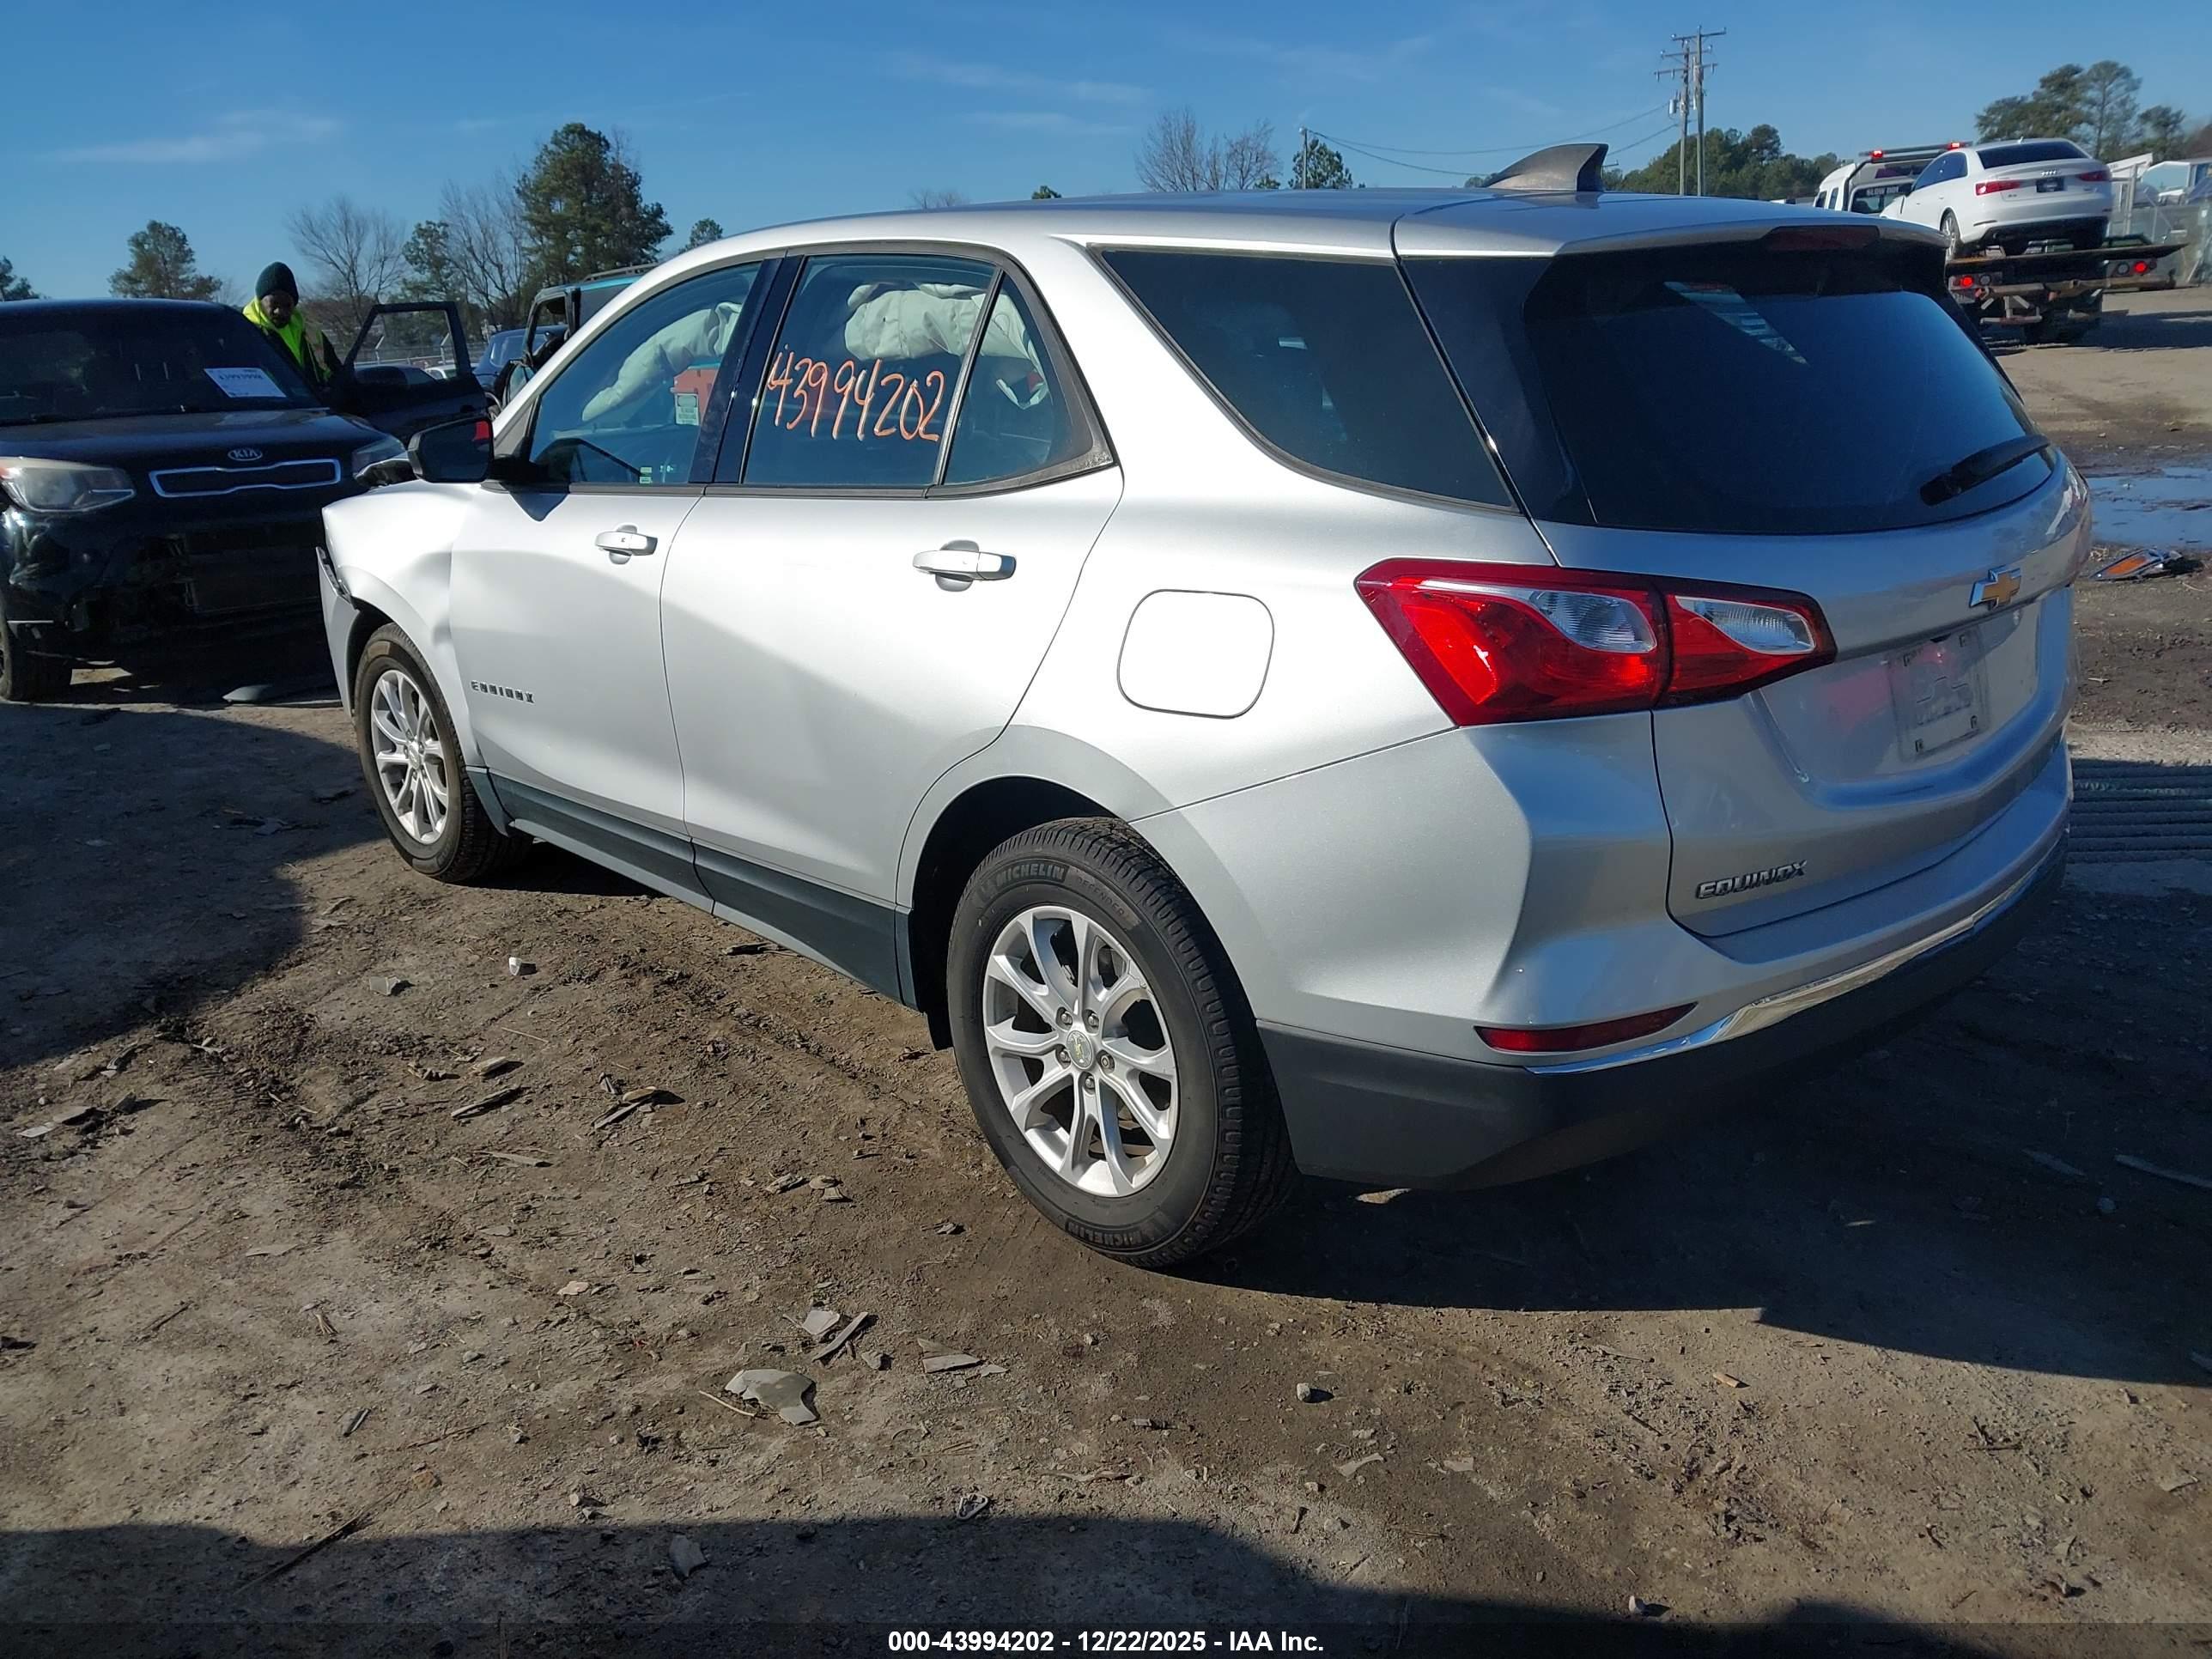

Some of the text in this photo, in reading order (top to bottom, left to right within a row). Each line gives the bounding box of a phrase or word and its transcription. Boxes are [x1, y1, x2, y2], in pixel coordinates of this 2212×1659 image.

[767, 343, 945, 441] 43994202
[470, 679, 536, 705] EQUINOX
[995, 862, 1066, 888] MICHELIN
[1695, 859, 1808, 899] EQUINOX
[1066, 1221, 1144, 1246] MICHELIN
